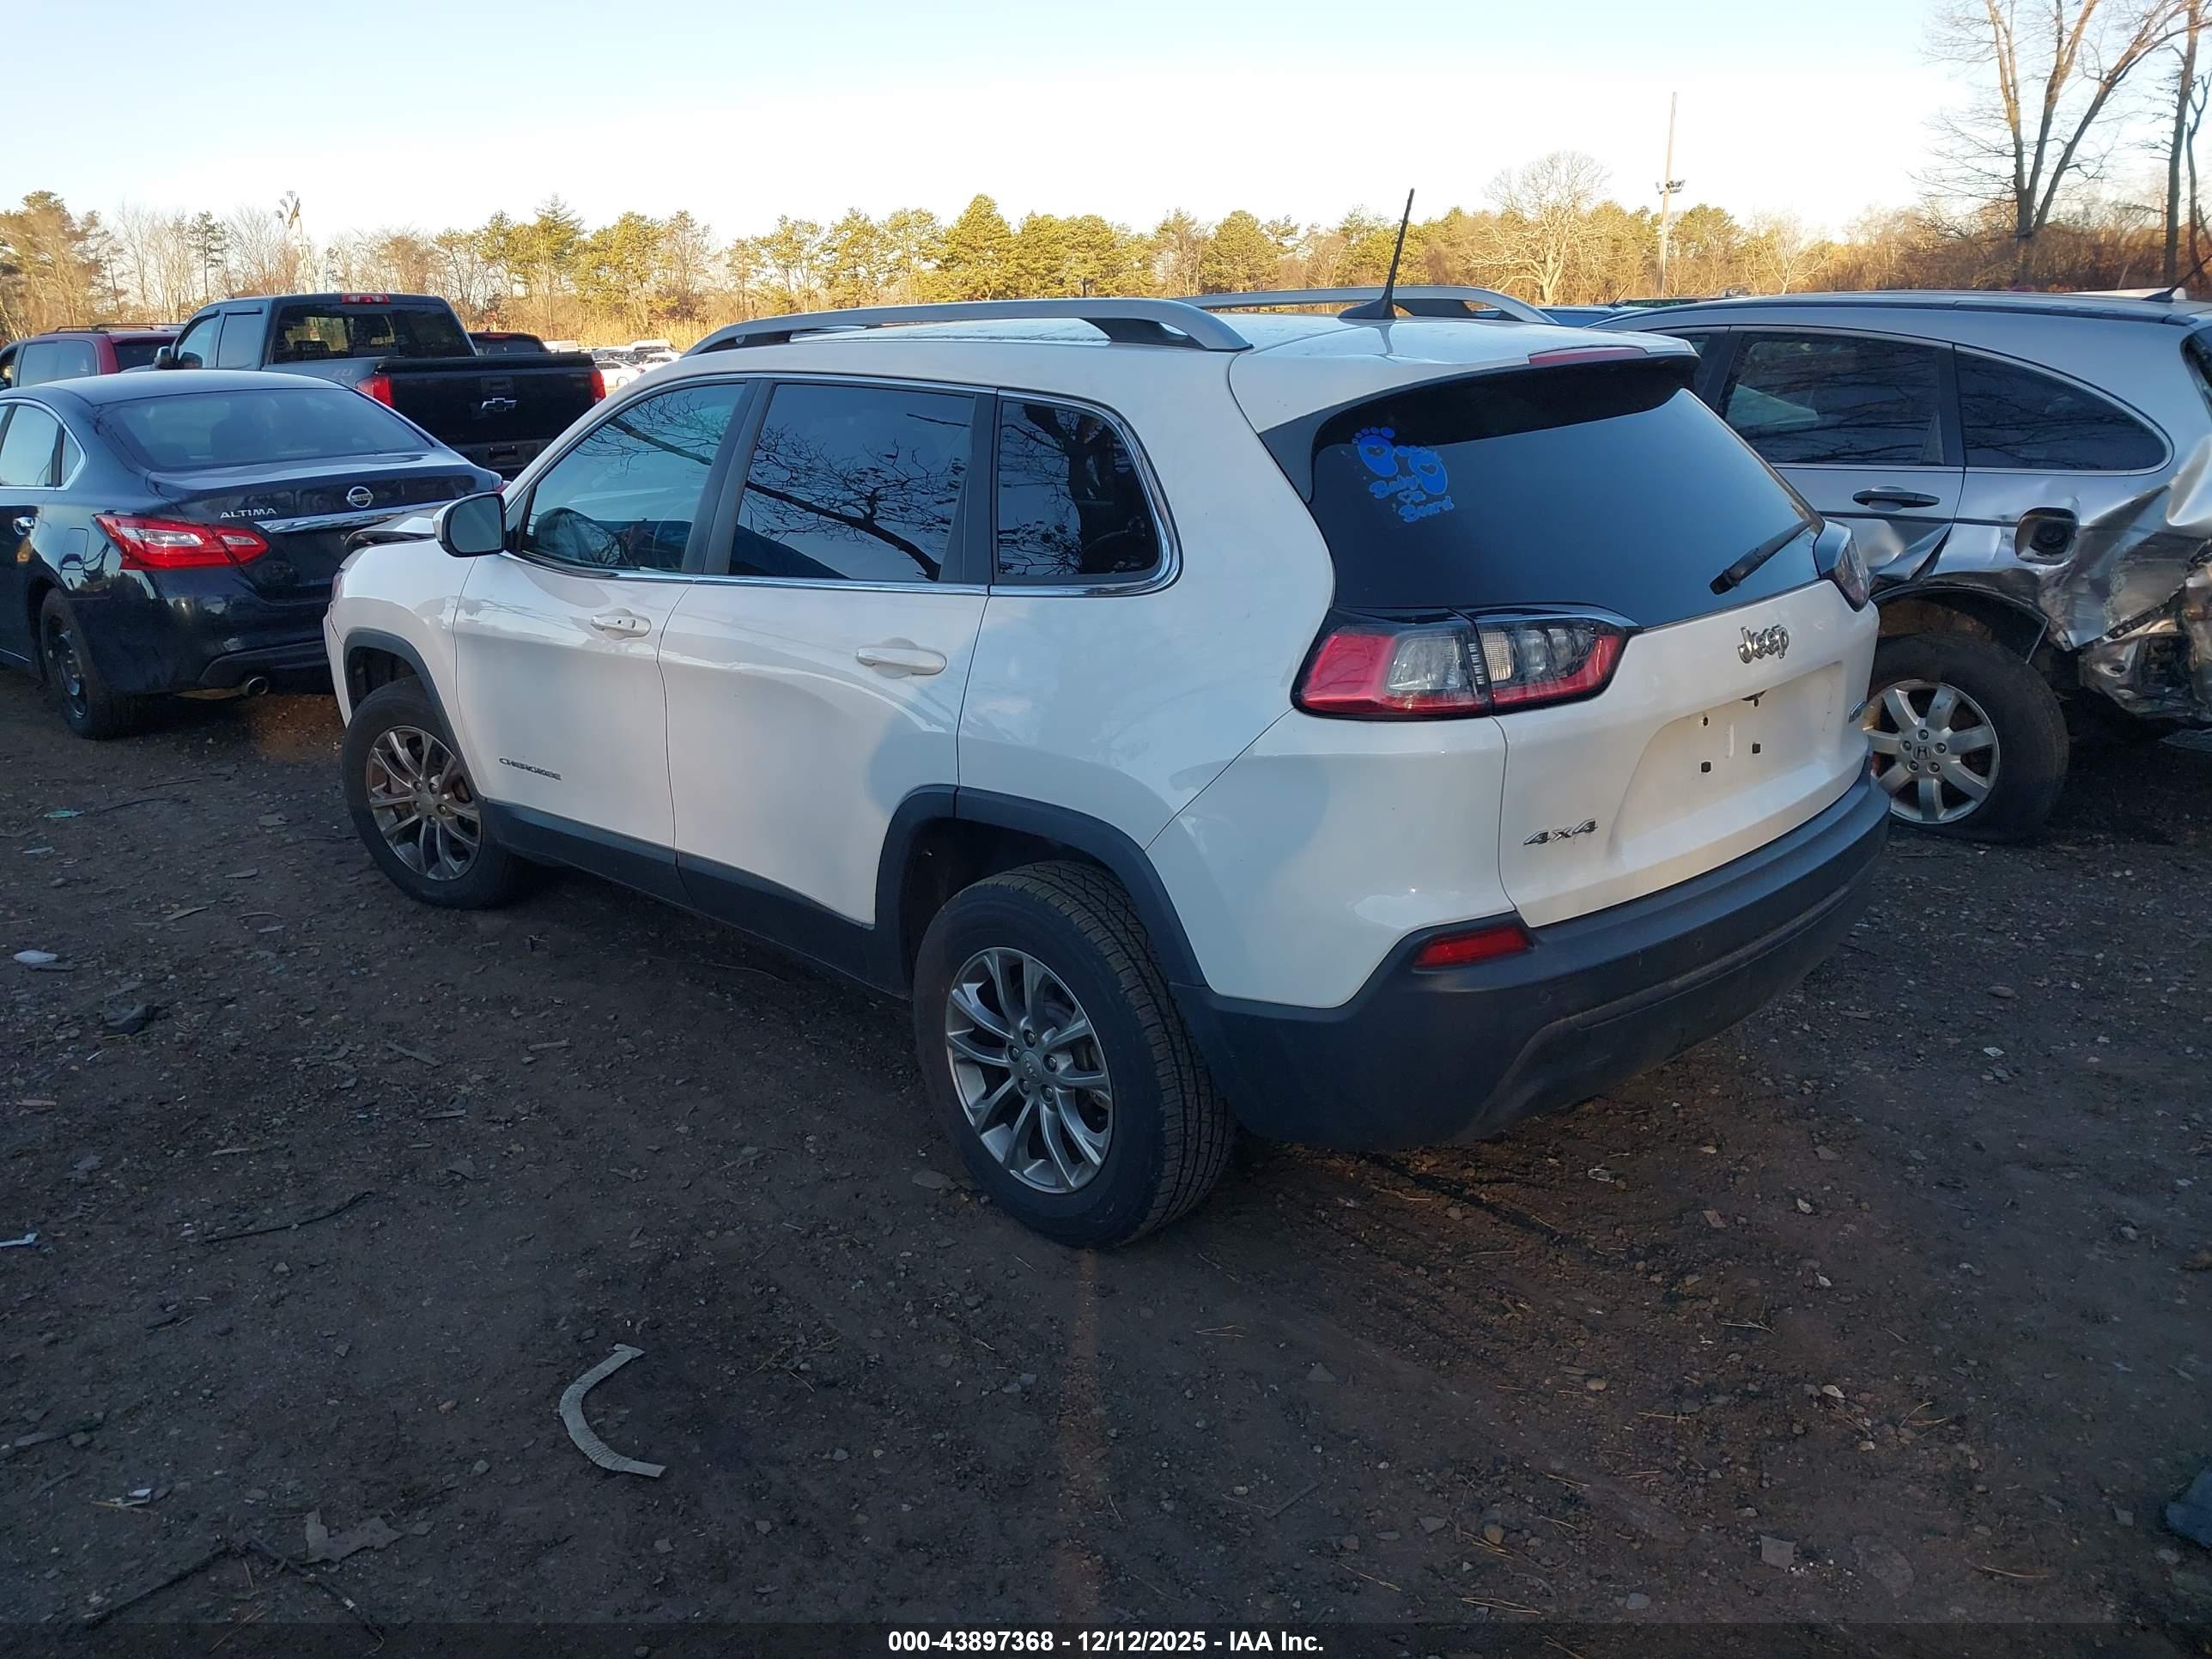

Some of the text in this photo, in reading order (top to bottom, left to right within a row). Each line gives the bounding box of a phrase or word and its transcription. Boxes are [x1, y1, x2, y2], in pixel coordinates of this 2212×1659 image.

[220, 507, 277, 519] ALTIMA
[1737, 624, 1790, 664] Jeep
[499, 757, 562, 781] CHEROKEE
